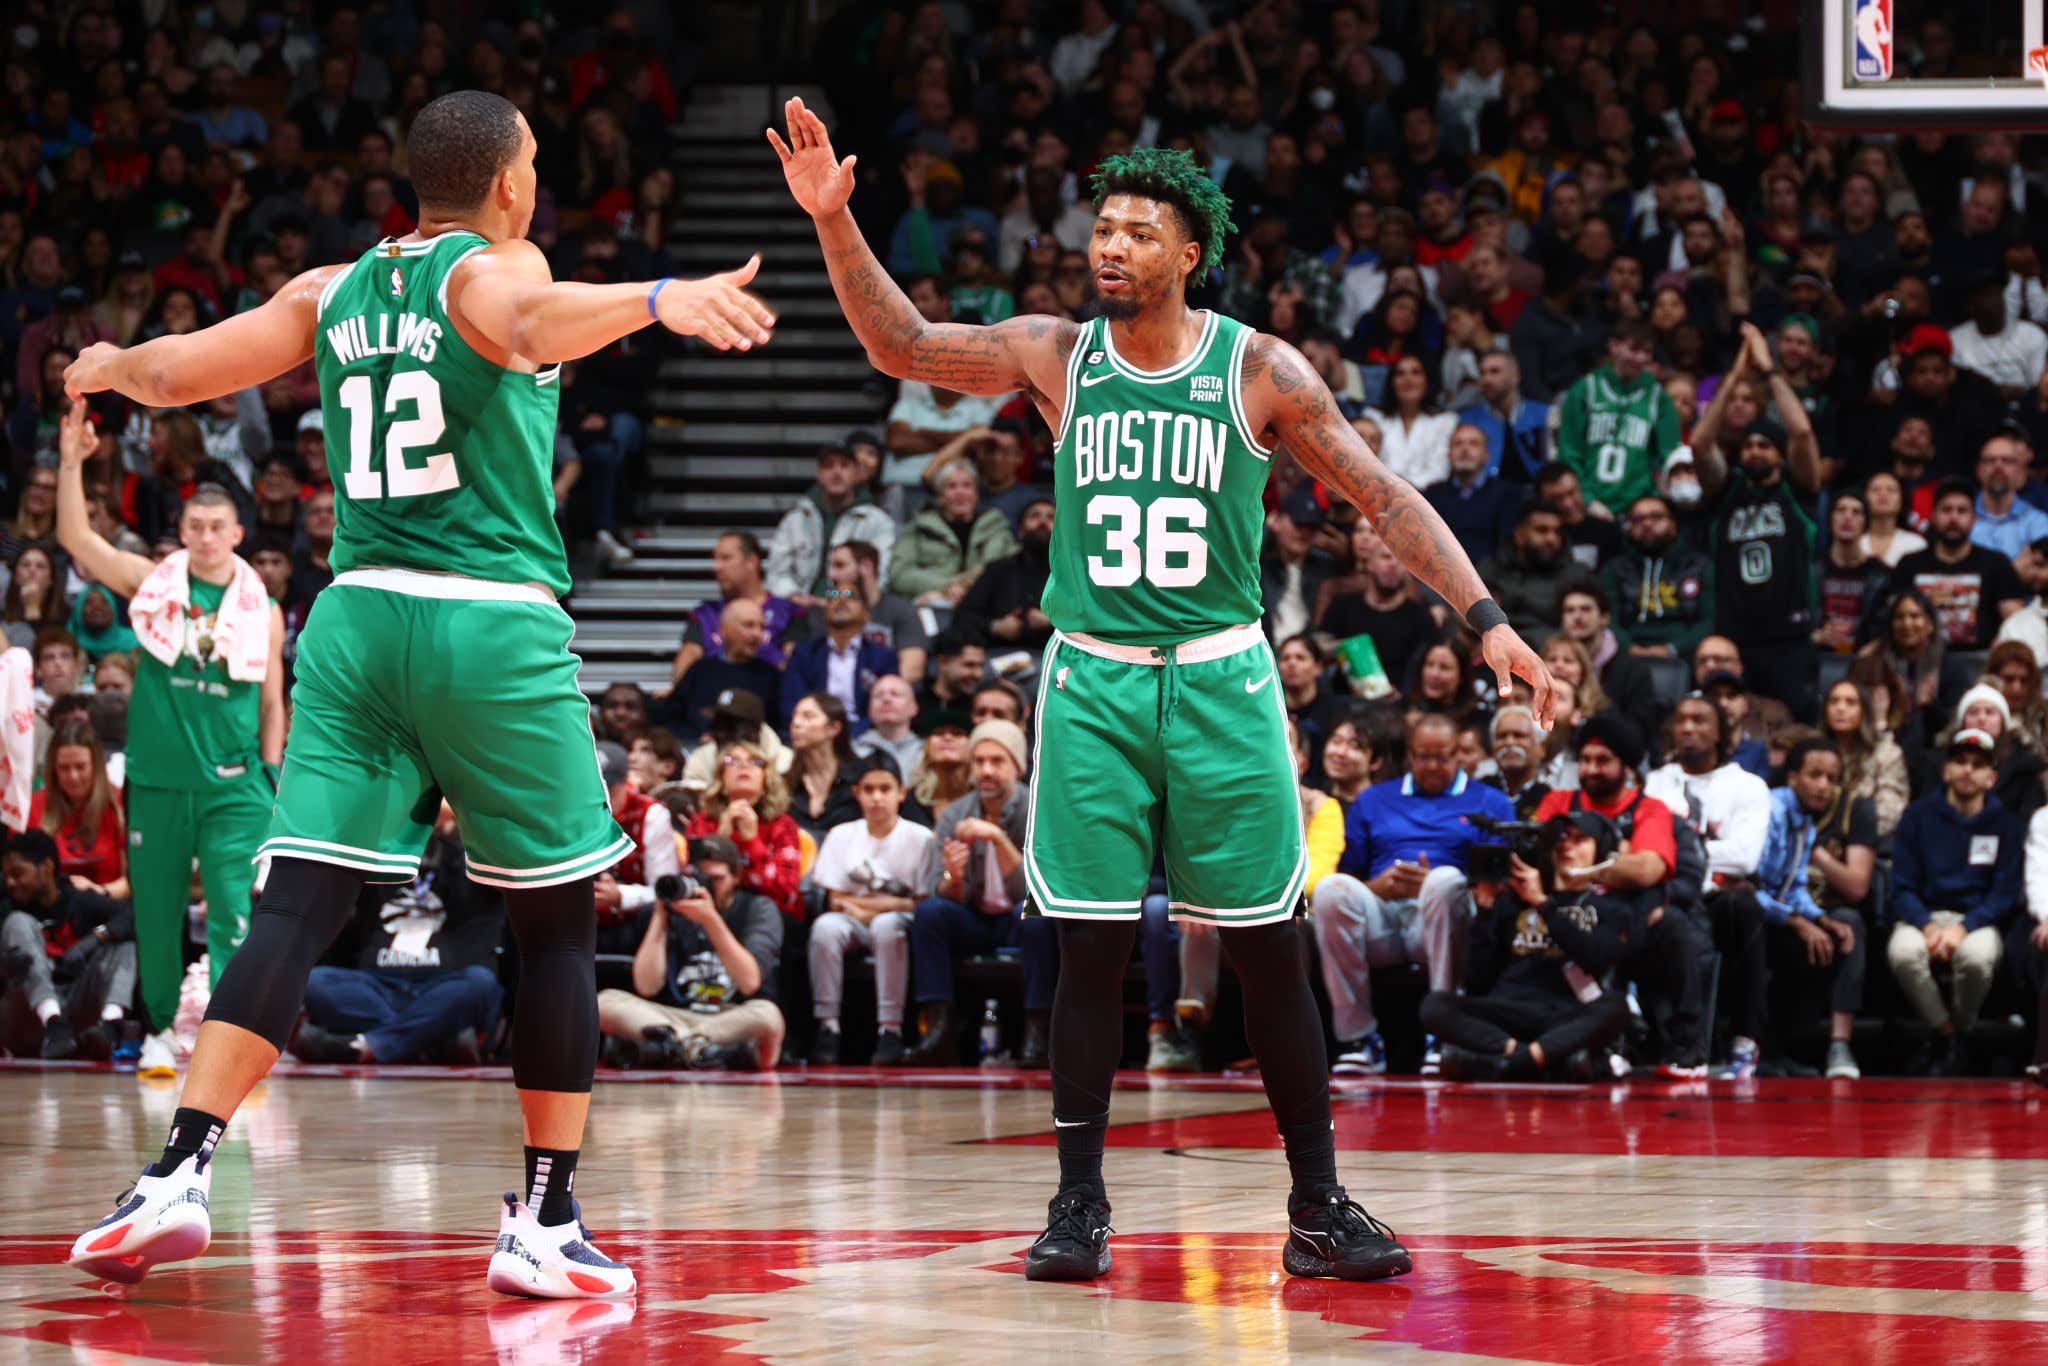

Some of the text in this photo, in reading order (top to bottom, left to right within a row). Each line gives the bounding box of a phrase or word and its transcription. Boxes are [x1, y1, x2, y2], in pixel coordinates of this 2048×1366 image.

[1087, 351, 1105, 365] 6
[1189, 390, 1224, 403] PRINT
[1190, 375, 1224, 392] VISTA
[339, 369, 461, 499] 12
[1075, 410, 1228, 493] BOSTON
[1596, 442, 1627, 483] 0
[1086, 494, 1208, 588] 36
[1739, 540, 1772, 585] 0
